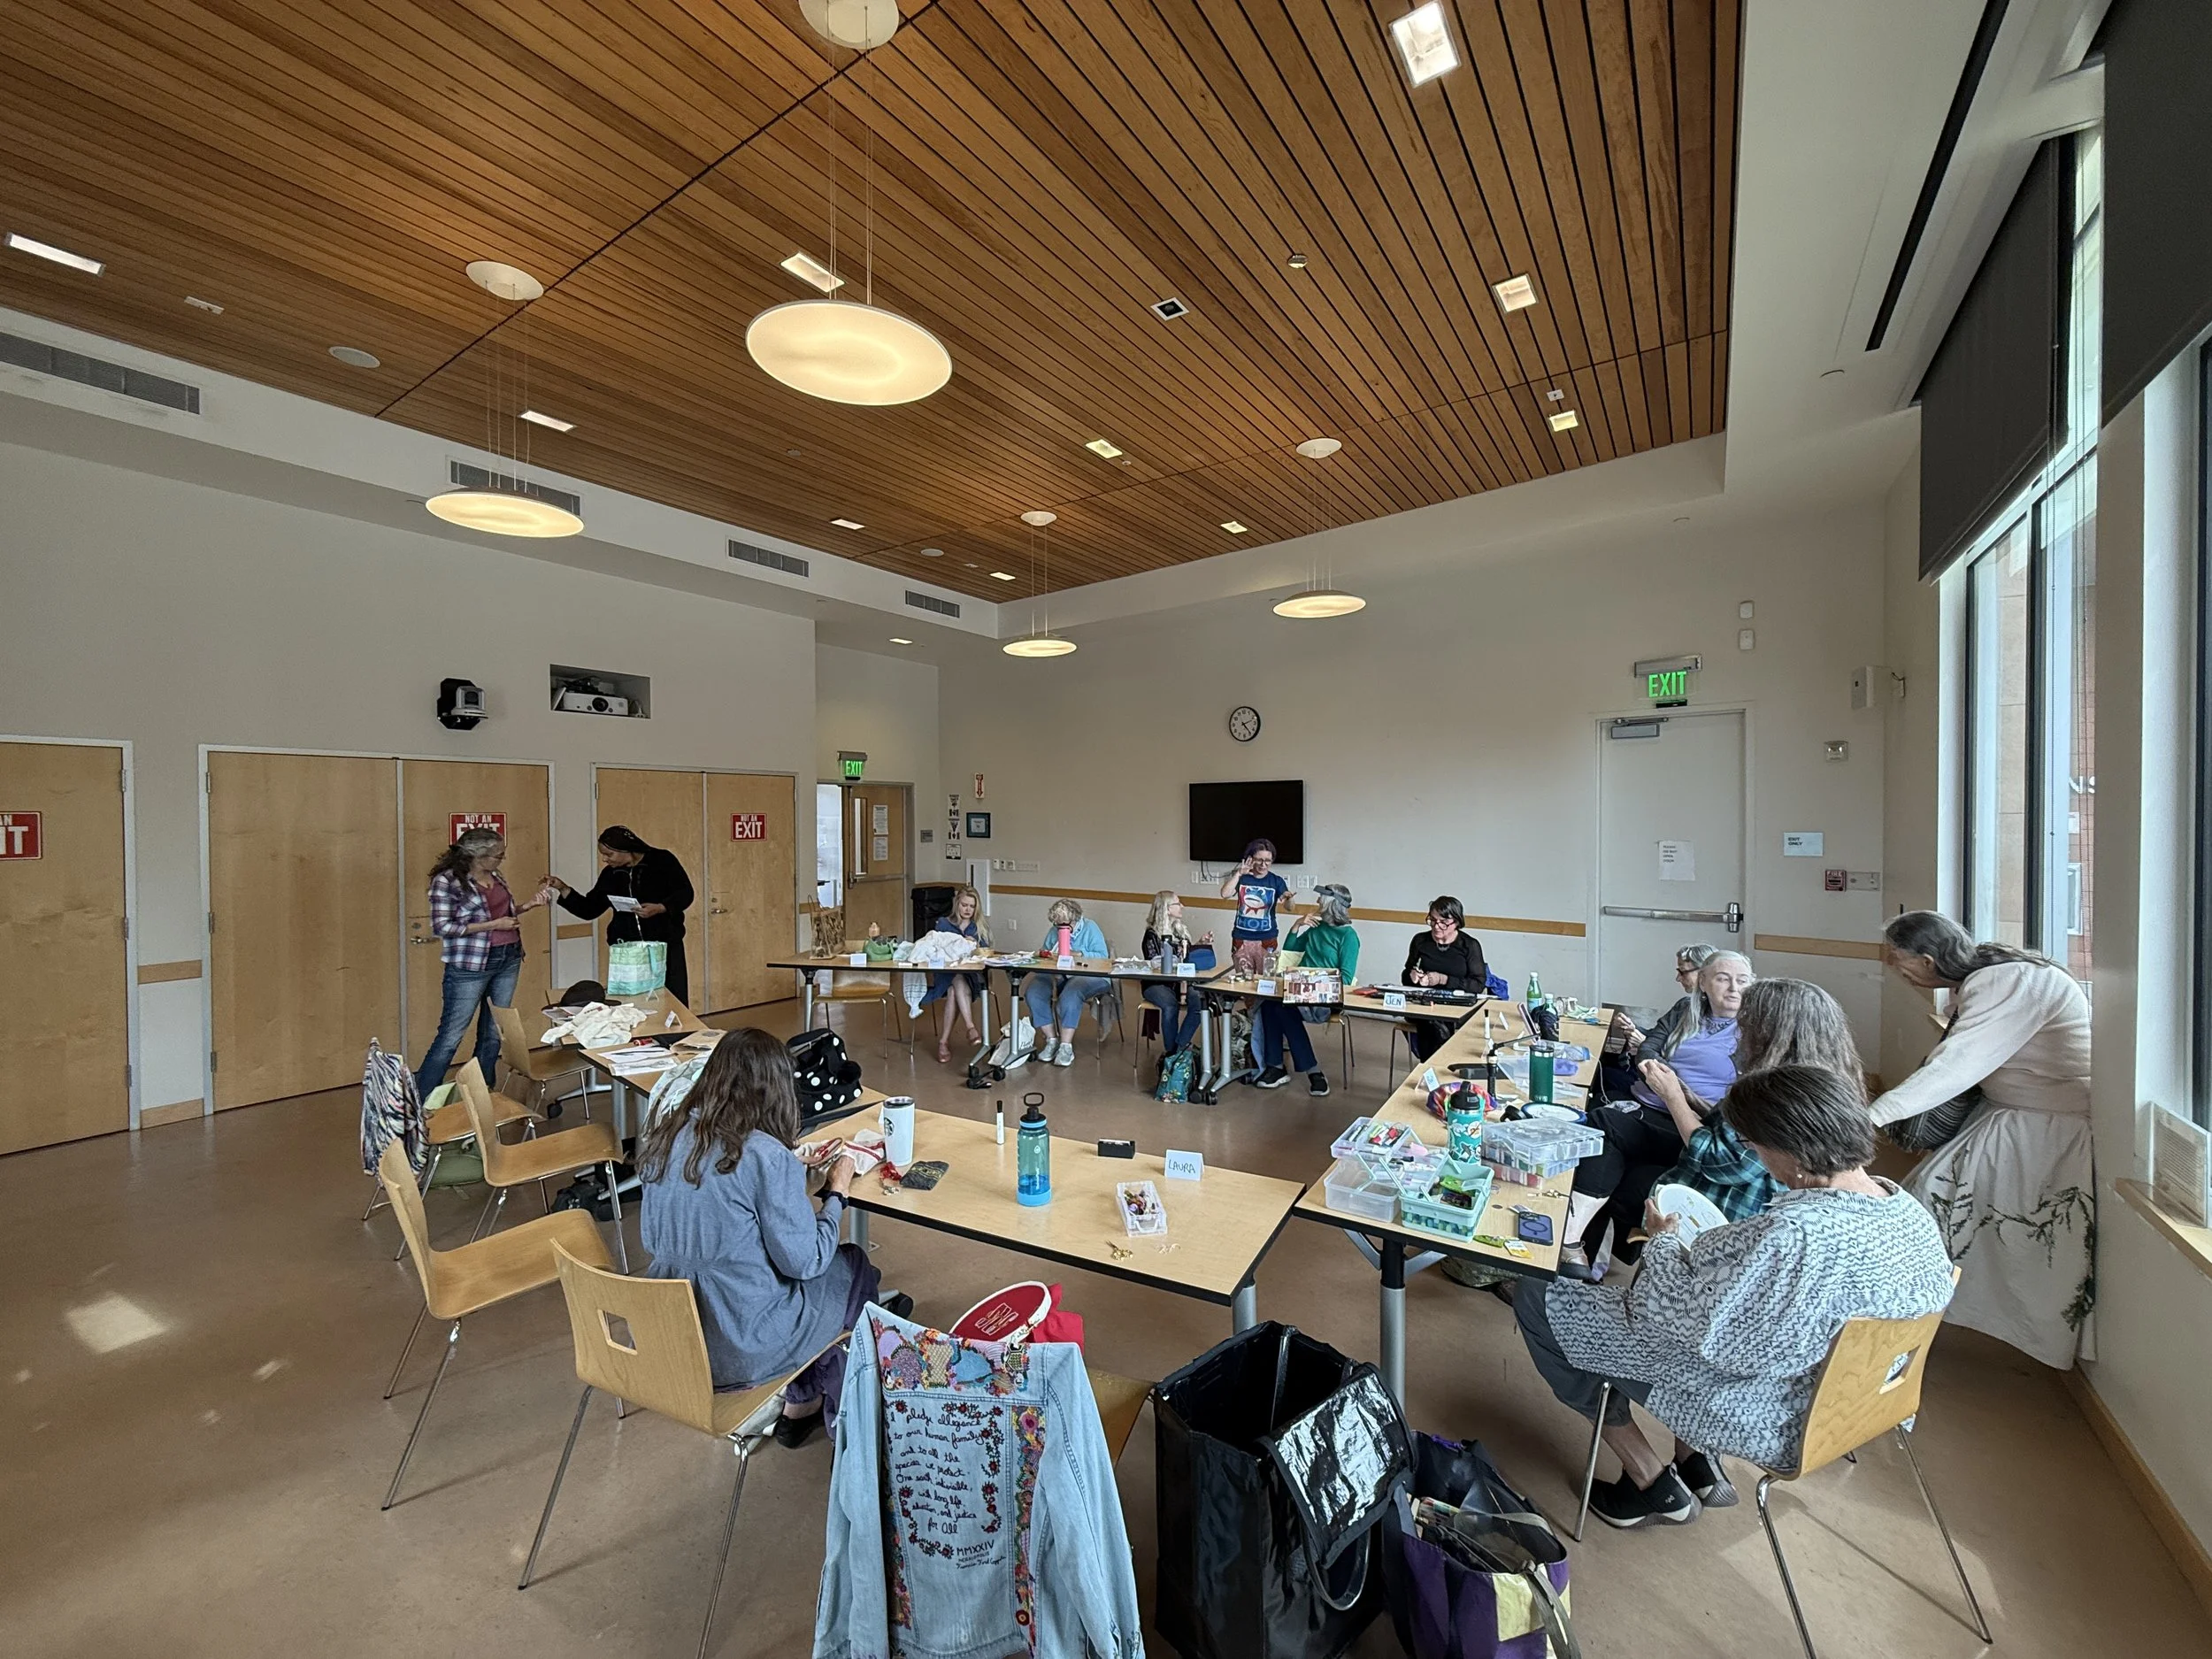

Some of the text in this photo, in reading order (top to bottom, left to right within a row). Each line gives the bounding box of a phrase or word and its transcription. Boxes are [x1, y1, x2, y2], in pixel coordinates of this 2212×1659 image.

[1648, 671, 1687, 697] EXIT
[846, 760, 864, 776] EXIT
[465, 814, 492, 823] NOT AN
[735, 822, 763, 839] EXIT
[1238, 918, 1269, 930] HOP
[1386, 995, 1402, 1006] JEN
[1168, 1158, 1196, 1174] LAURA
[906, 1408, 933, 1426] pledge
[925, 1427, 949, 1442] human
[951, 1430, 985, 1449] family
[900, 1445, 960, 1463] and to all the
[895, 1473, 913, 1484] One
[918, 1489, 932, 1500] with
[934, 1489, 949, 1509] long
[940, 1509, 952, 1518] and
[927, 1517, 958, 1534] for All
[956, 1539, 995, 1556] MMXXIV
